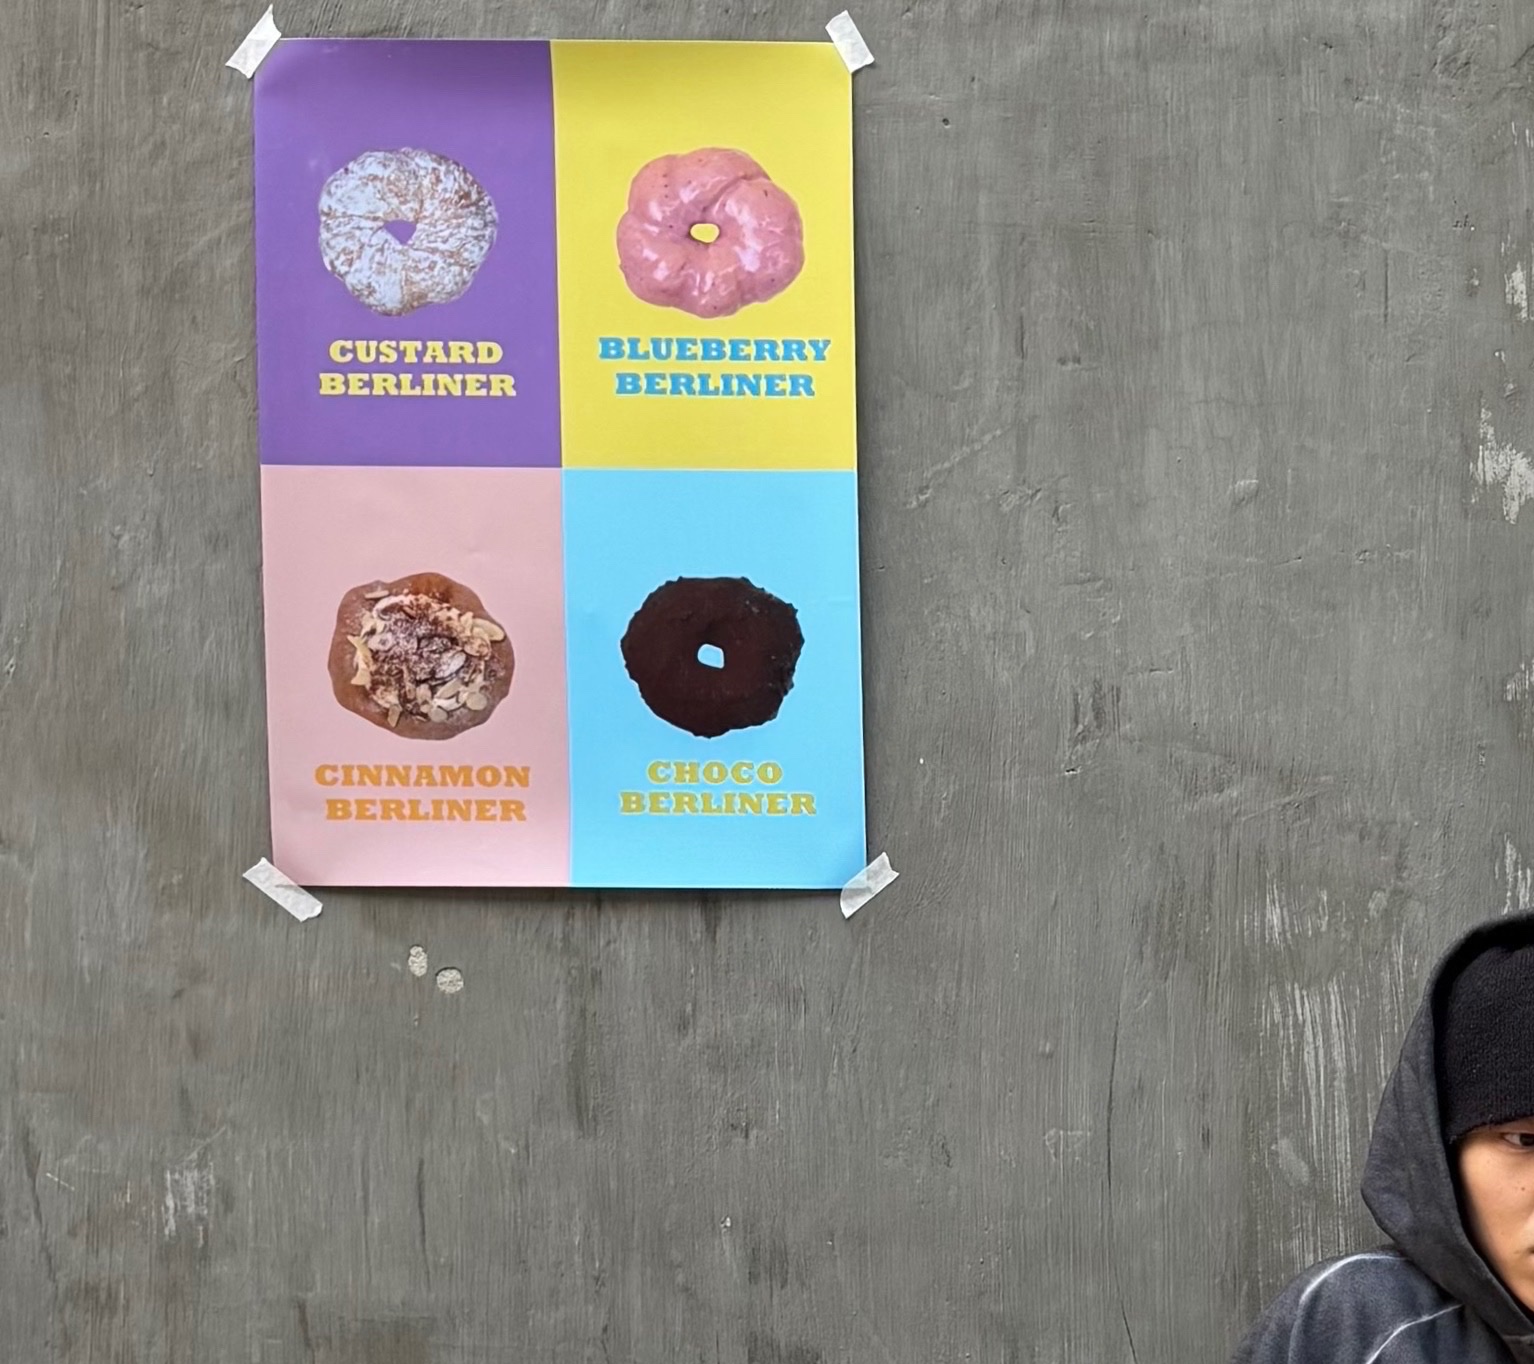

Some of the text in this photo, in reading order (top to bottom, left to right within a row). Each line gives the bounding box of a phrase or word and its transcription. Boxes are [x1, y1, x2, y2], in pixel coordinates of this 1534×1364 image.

[329, 340, 504, 364] CUSTARD
[598, 337, 831, 361] BLUEBERRY
[319, 373, 517, 396] BERLINER
[615, 372, 815, 397] BERLINER
[314, 764, 531, 788] CINNAMON
[647, 760, 782, 784] CHOCO
[326, 798, 527, 821] BERLINER
[620, 791, 816, 815] BERLINER
